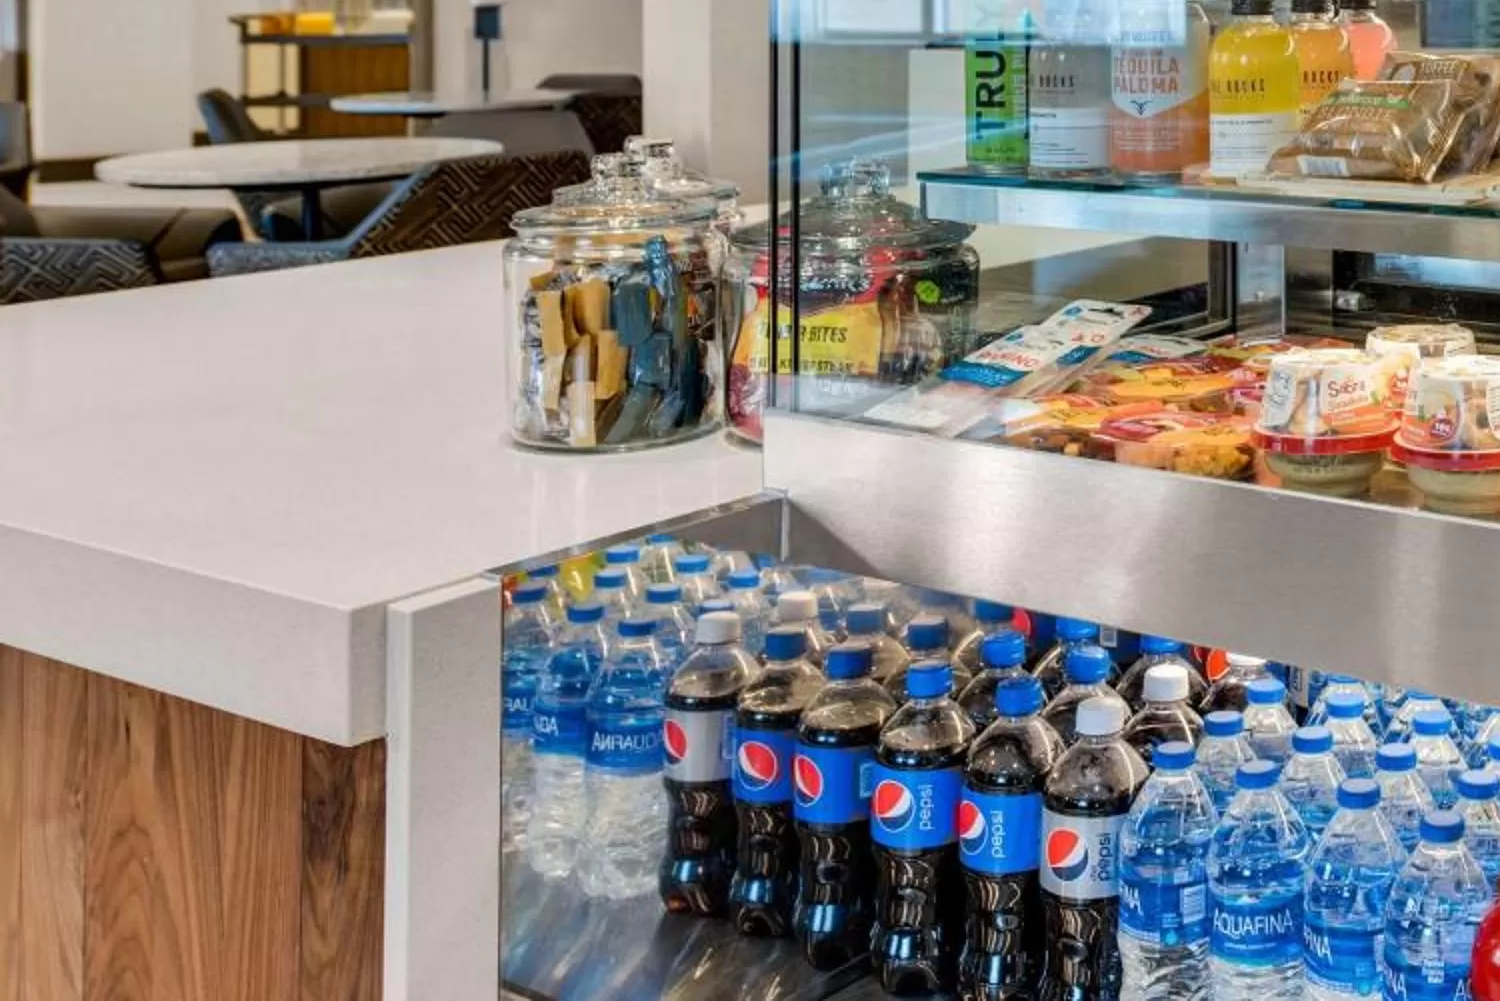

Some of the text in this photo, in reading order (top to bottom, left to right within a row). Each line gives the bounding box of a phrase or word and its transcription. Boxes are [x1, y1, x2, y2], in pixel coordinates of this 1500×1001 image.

[1113, 55, 1181, 76] TEQUILA
[1113, 76, 1180, 94] PALOMA
[809, 325, 849, 344] BITES
[918, 783, 934, 831] pepsi
[991, 809, 1005, 859] pepsi
[1097, 830, 1114, 881] pepsi
[1212, 908, 1295, 938] AQUAFINA
